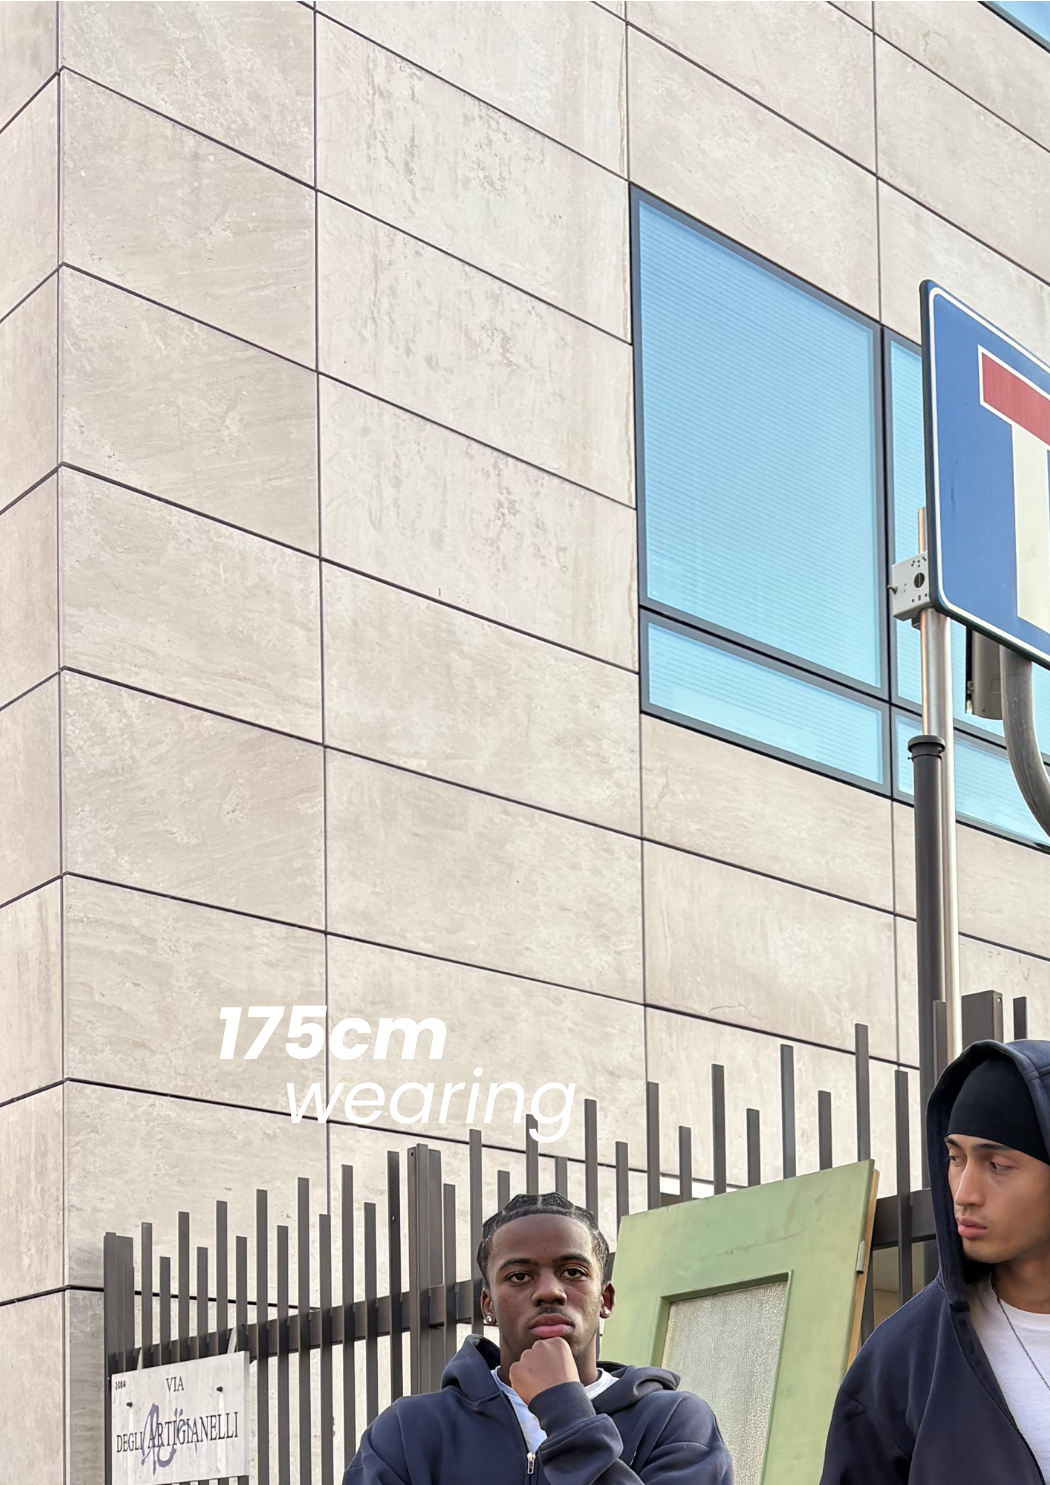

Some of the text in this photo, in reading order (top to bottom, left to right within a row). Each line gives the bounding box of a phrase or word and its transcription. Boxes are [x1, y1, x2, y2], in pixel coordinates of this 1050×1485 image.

[166, 1376, 184, 1392] VIA
[116, 1411, 239, 1453] DEGLI ARTIGIANELLI
